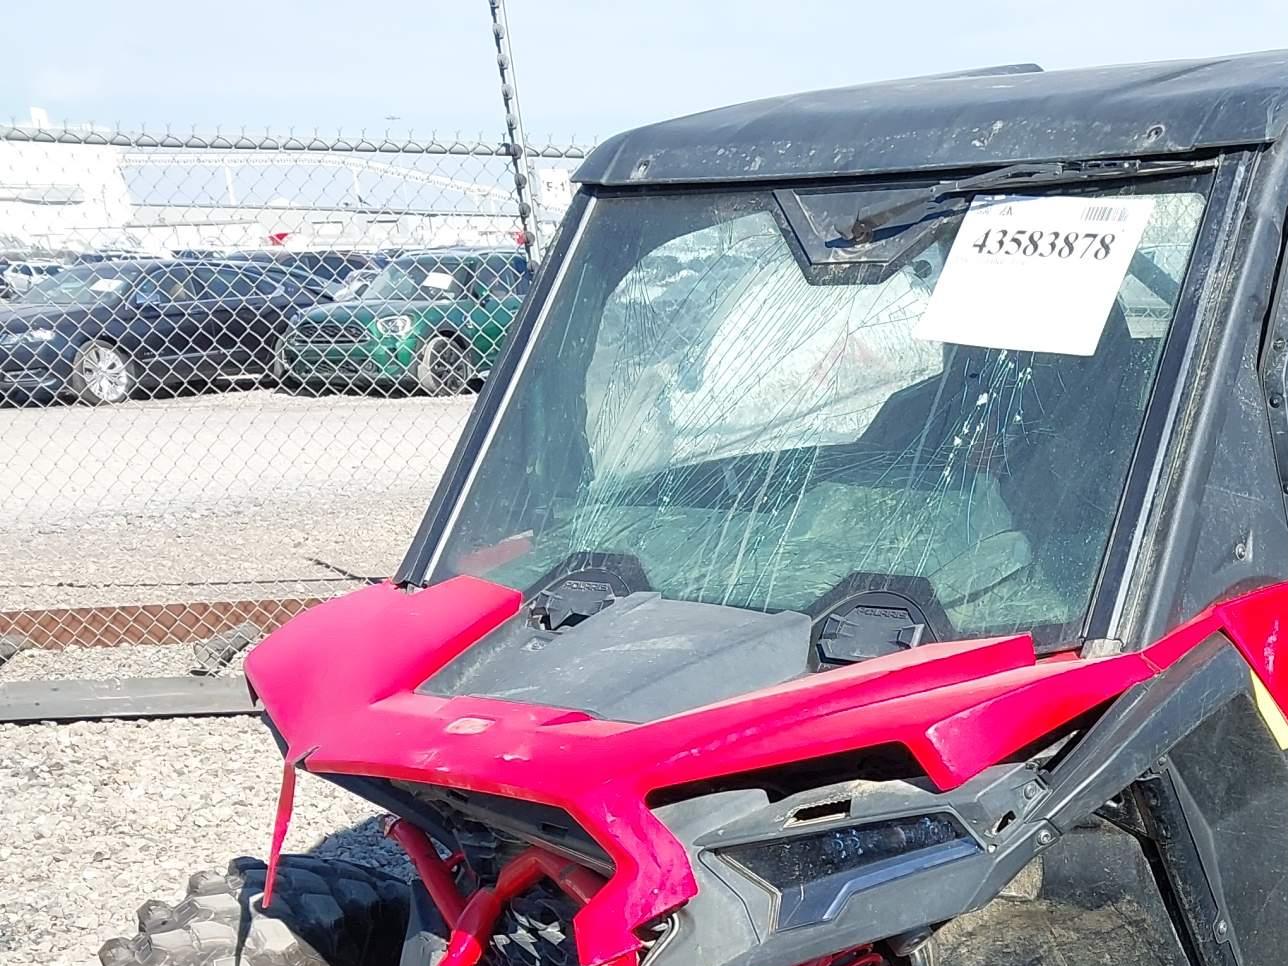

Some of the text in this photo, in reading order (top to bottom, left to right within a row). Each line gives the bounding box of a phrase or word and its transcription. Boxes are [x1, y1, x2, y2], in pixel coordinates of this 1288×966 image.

[972, 228, 1116, 261] 43583878
[562, 580, 609, 592] POLARIS
[856, 606, 908, 619] POLARIS
